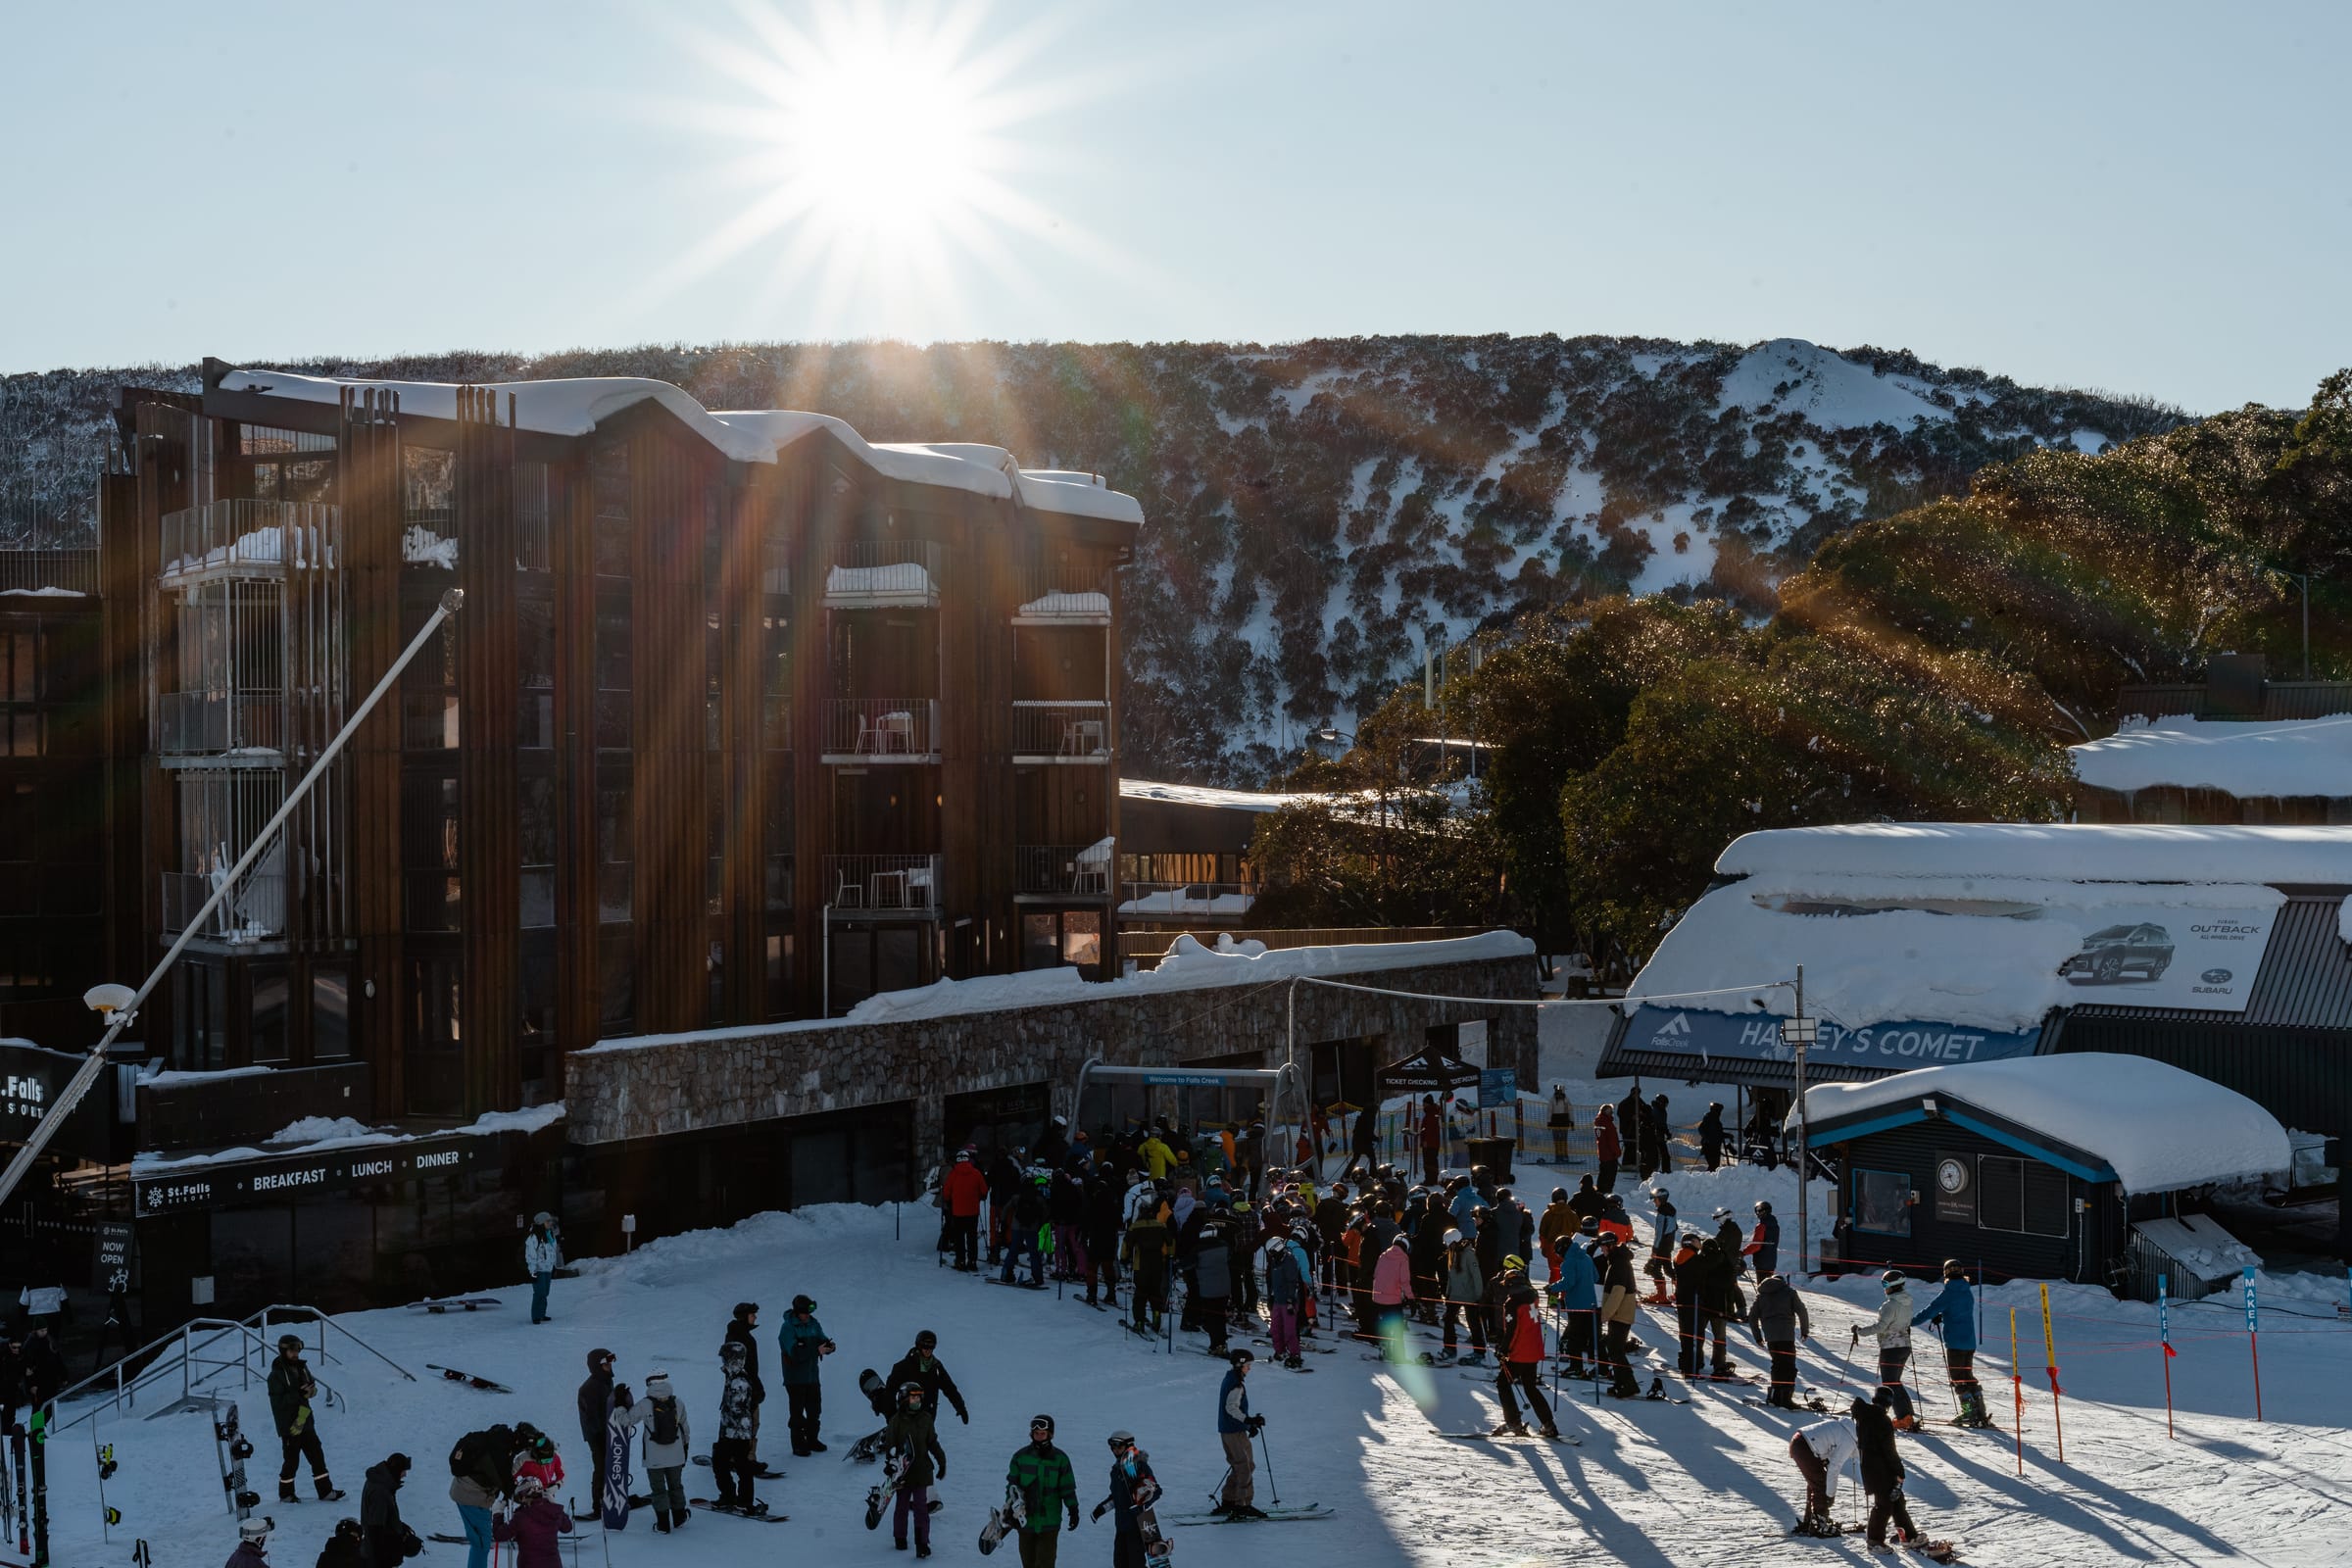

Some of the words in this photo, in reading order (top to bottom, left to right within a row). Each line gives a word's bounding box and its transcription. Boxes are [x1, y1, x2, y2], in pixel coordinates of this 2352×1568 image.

[2190, 924, 2262, 934] OUTBACK
[2192, 986, 2233, 995] SUBARU
[1740, 1021, 1874, 1054] HAEY'S
[1880, 1030, 1985, 1060] COMET
[253, 1168, 326, 1192] BREAKFAST
[351, 1159, 393, 1178] LUNCH
[416, 1151, 460, 1169] DINNER
[168, 1183, 212, 1198] St.Falls
[102, 1242, 124, 1252] NOW
[100, 1254, 123, 1264] OPEN
[2244, 1278, 2256, 1319] MAKE
